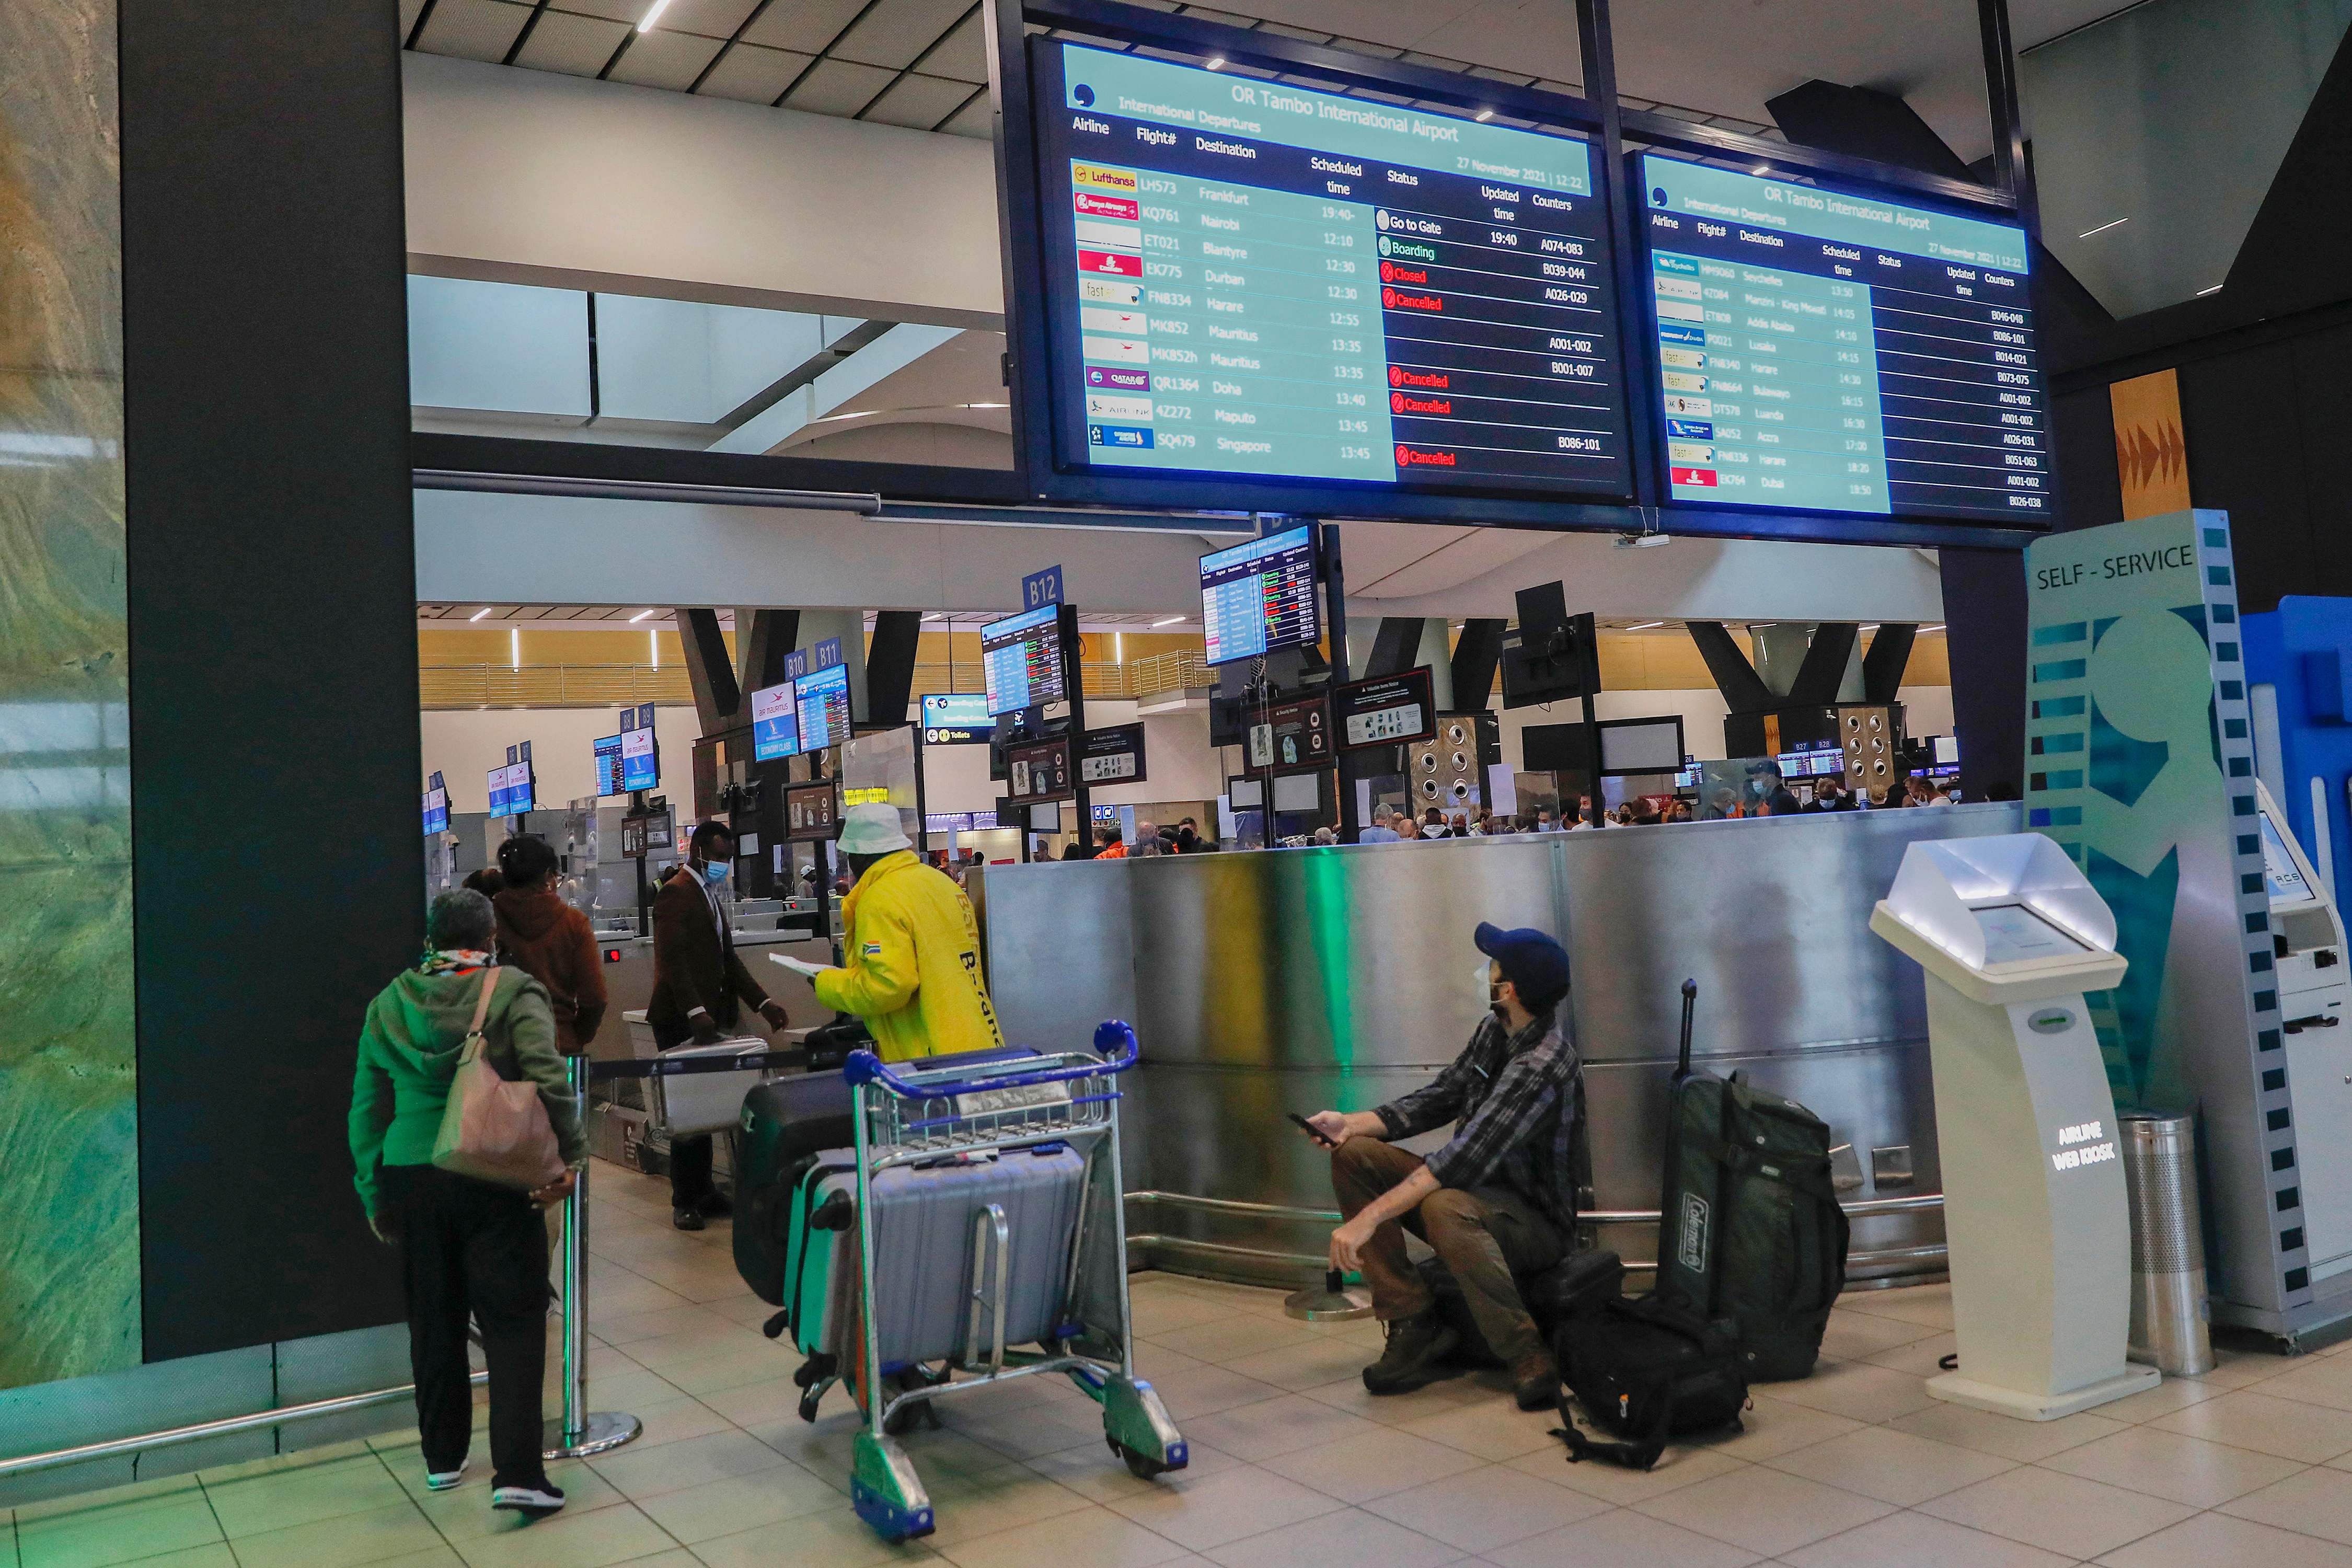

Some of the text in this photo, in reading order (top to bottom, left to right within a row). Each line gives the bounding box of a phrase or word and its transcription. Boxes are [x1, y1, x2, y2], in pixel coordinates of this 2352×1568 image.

[1119, 97, 1261, 133] International Departures
[1232, 86, 1459, 143] OR Tambo International Airport
[1073, 117, 1572, 212] Airline Flight# Destination Scheduled Status Updated Counters
[1457, 157, 1582, 189] 27 November 2021 12:22
[1327, 181, 1351, 195] time
[1092, 171, 1135, 187] Lufthansa
[1140, 177, 1177, 195] LH573
[1199, 188, 1249, 206] Frankfurt
[1390, 216, 1404, 232] Go
[1406, 218, 1416, 230] to
[1419, 221, 1442, 235] Gate
[1491, 231, 1517, 246] 19:40
[1541, 238, 1583, 256] A074-083
[1494, 207, 1515, 222] time
[1684, 197, 1786, 226] International Departures
[1765, 187, 1930, 230] OR Tambo International Airport
[1142, 207, 1180, 223] KQ761
[1201, 215, 1239, 231] Nairobi
[1324, 233, 1353, 247] 12:10
[1392, 242, 1434, 261] Boarding
[1542, 263, 1585, 280] B039-044
[1652, 214, 2015, 287] Airline Flight# Destination Scheduled Status Updated Counters
[1145, 234, 1588, 304] ET021 Blantyre 12:30 Closed A026-029
[1743, 271, 1783, 287] Seychelles
[1834, 263, 1852, 277] time
[1146, 263, 1442, 311] EK775 Durban 12:30 Cancelled
[1956, 284, 1973, 296] time
[1207, 298, 1244, 314] Harare
[1330, 313, 1359, 327] 12:55
[1549, 338, 1592, 353] A001-002
[1150, 319, 1594, 377] MK852 Mauritius 13:35 B001-007
[1994, 351, 2027, 365] B014-021
[1210, 353, 1260, 369] Mauritius
[1334, 366, 1364, 380] 13:35
[1403, 372, 1448, 388] Cancelled
[1751, 361, 1778, 375] Harare
[1999, 393, 2032, 406] A001-002
[1997, 371, 2030, 385] B073-075
[1154, 376, 1200, 392] QR1364
[1213, 381, 1242, 396] Doha
[1336, 393, 1366, 406] 13:40
[1405, 398, 1450, 414] Cancelled
[1156, 406, 1600, 452] 4Z272 Maputo 13:45 B086-101
[1755, 408, 1784, 421] Luanda
[2003, 434, 2036, 446] A026-031
[2001, 413, 2034, 426] A001-002
[1158, 433, 1455, 466] SQ479 Singapore 13:45 Cancelled
[1759, 454, 1786, 466] Harare
[2007, 475, 2040, 488] A001-002
[2037, 563, 2083, 590] SELF
[2104, 545, 2193, 579] SERVICE
[1030, 574, 1056, 605] B12
[788, 655, 803, 677] B10
[820, 643, 837, 667] B11
[624, 714, 631, 730] B8
[643, 708, 650, 724] B9
[766, 702, 789, 715] MAURITIUS
[761, 742, 791, 756] ECONOMY CLASS
[2059, 1121, 2103, 1146] AIRLINE
[2052, 1142, 2116, 1171] WEB KIOSK
[1687, 1201, 1704, 1252] Coleman
